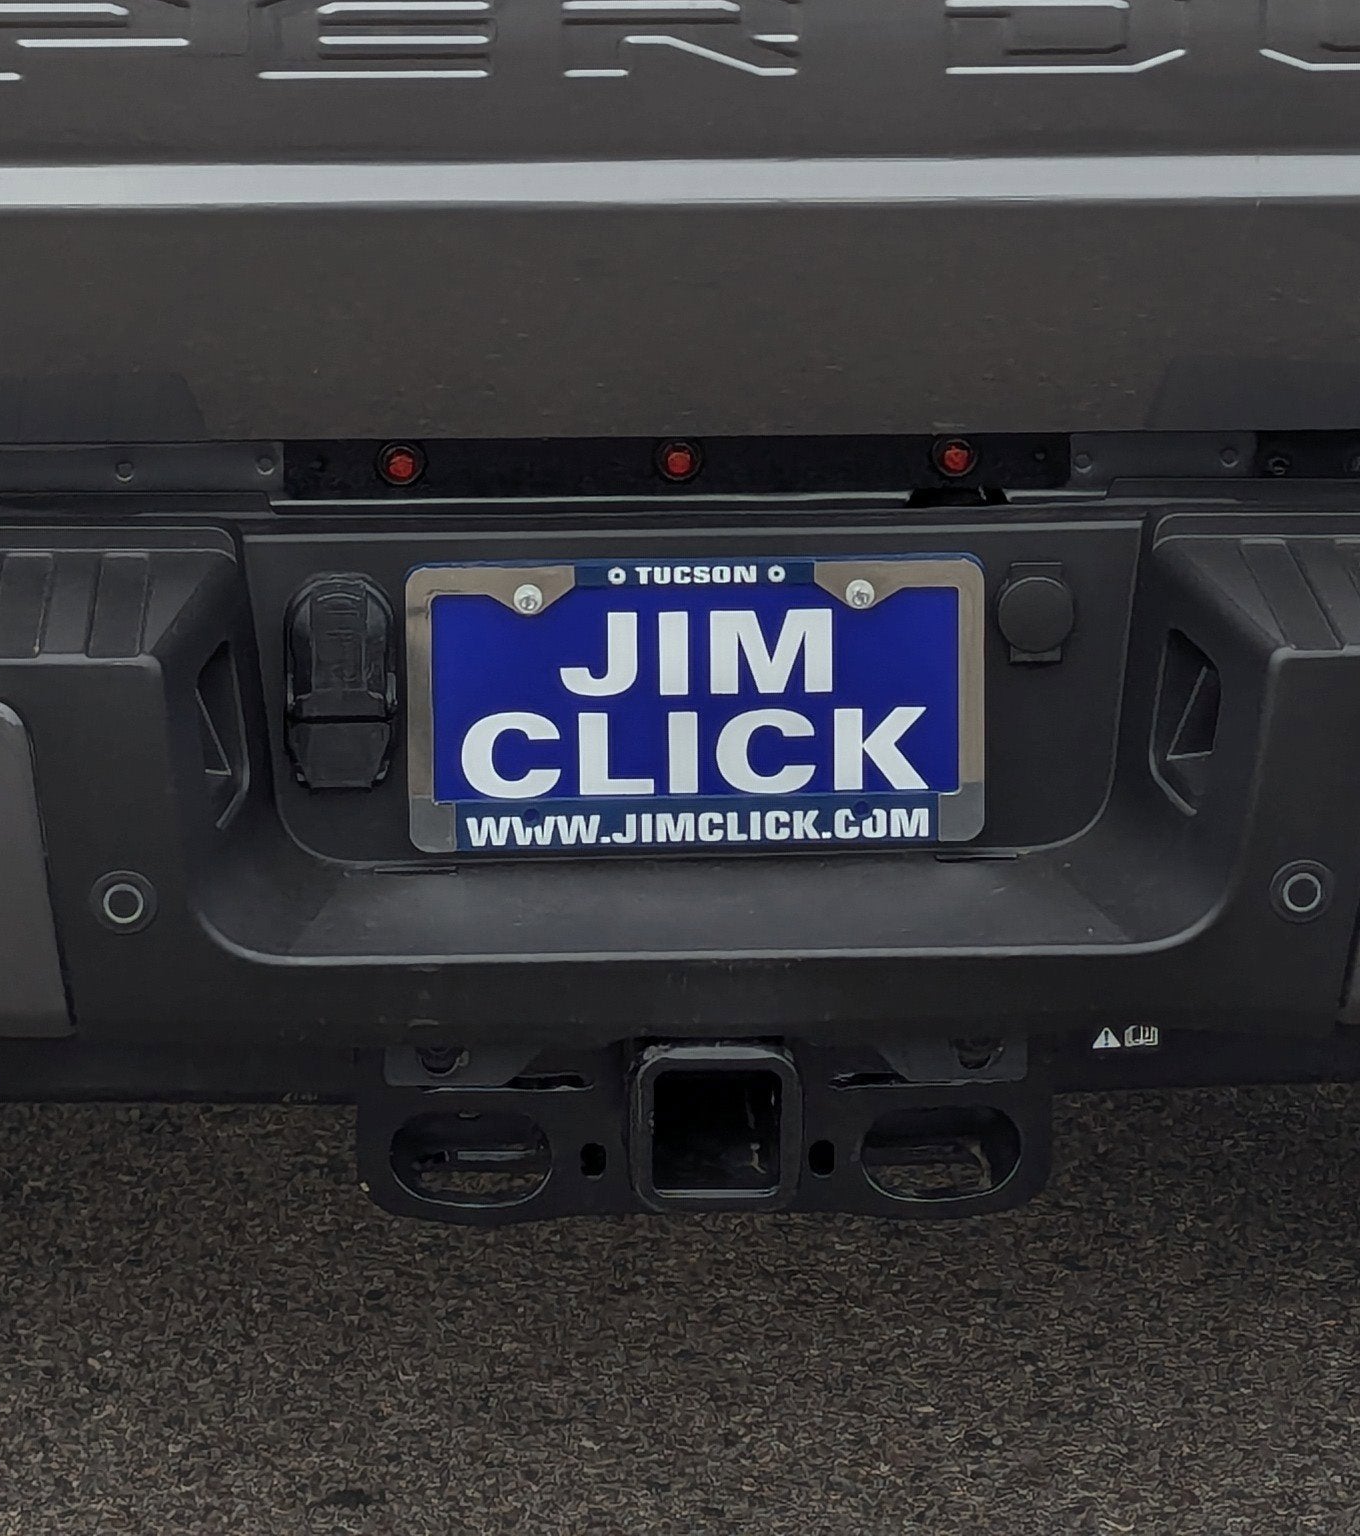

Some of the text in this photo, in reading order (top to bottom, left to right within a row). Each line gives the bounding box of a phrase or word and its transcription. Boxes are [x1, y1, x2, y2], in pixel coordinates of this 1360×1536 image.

[635, 565, 757, 584] TUCSON
[559, 608, 833, 697] JIM
[460, 706, 930, 799] CLICK
[466, 808, 930, 847] WWW.JIMCLICK.COM
